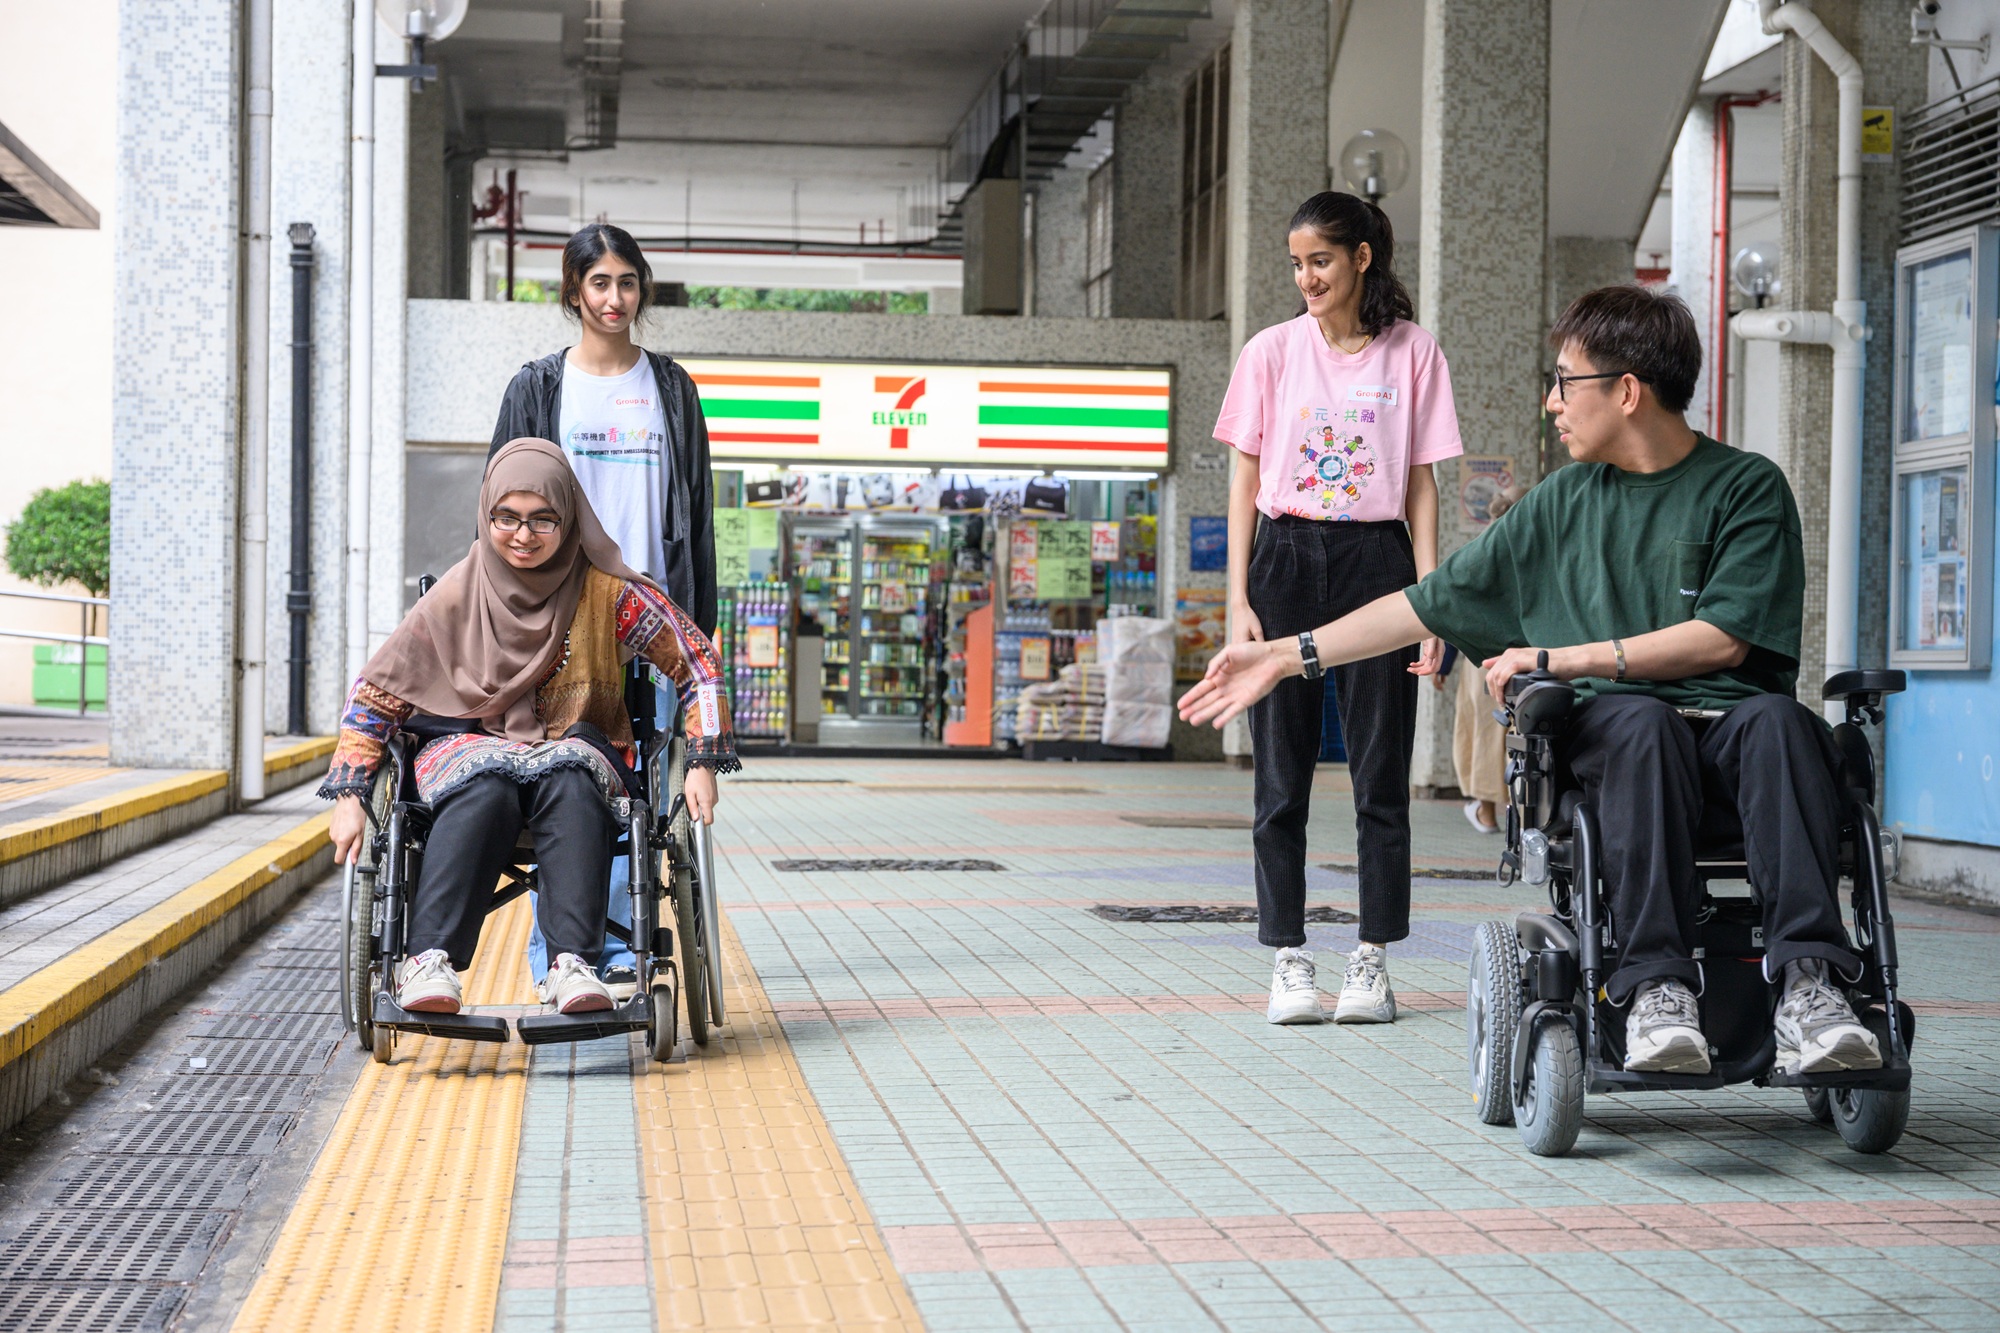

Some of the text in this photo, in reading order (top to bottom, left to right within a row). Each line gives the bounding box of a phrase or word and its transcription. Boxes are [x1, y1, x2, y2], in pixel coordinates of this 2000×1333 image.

[875, 376, 926, 449] 7
[1356, 389, 1393, 400] Group A1
[703, 689, 714, 729] Group A2
